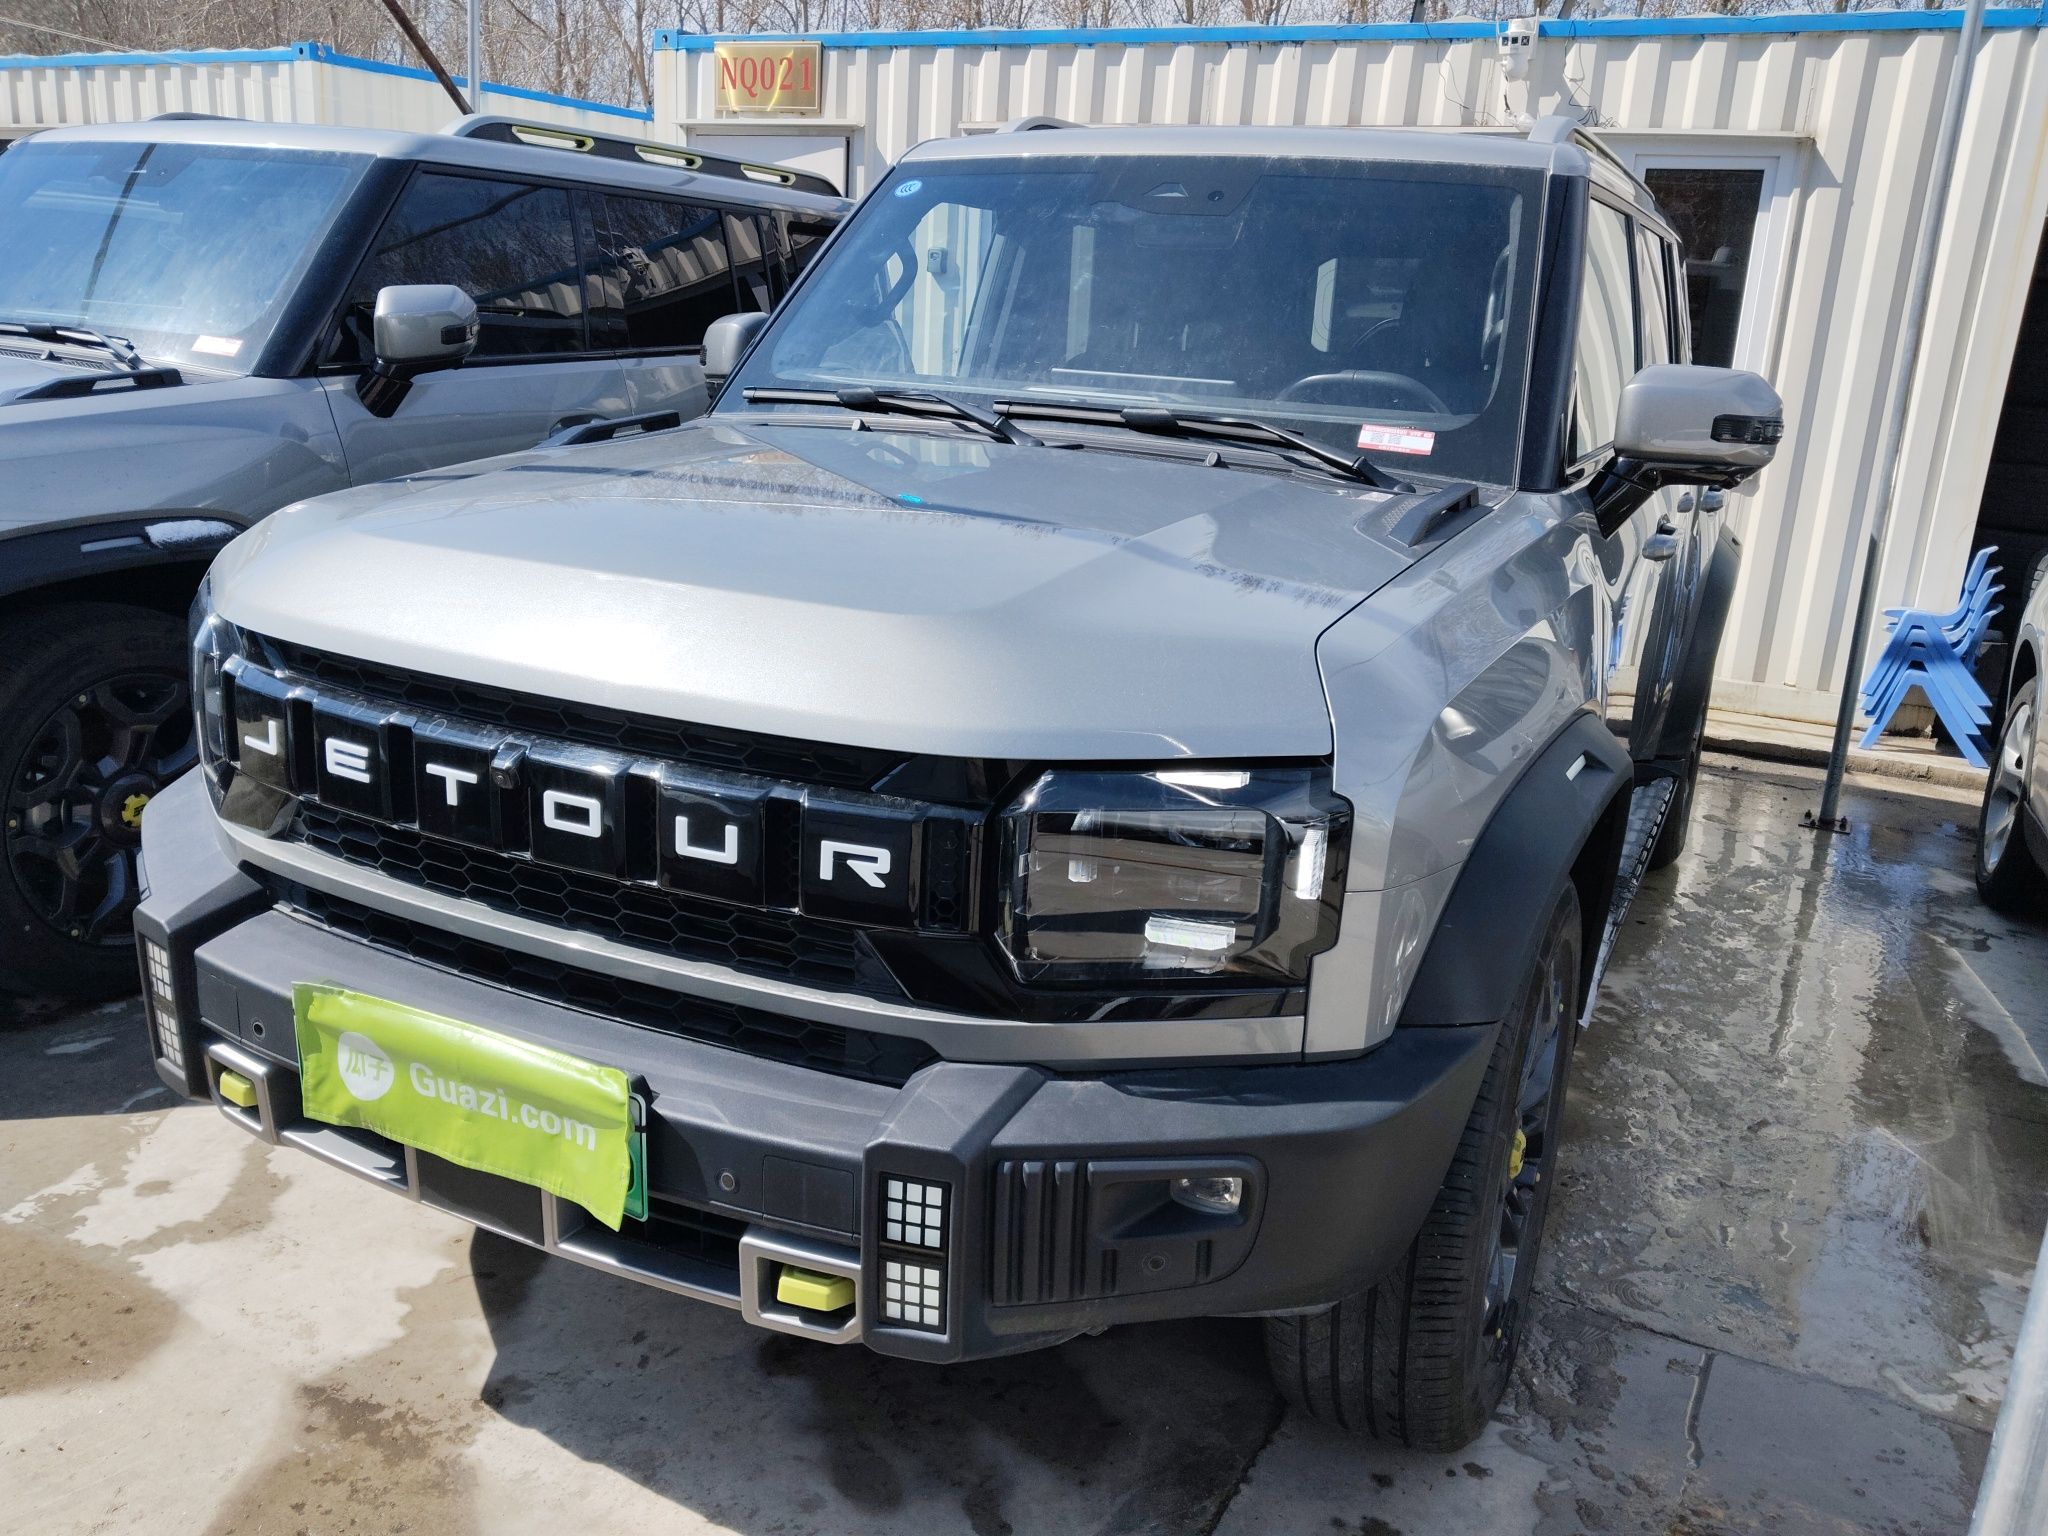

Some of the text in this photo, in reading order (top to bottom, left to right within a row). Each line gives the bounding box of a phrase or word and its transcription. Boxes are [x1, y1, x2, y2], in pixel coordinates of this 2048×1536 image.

[720, 57, 811, 98] NQ021
[243, 720, 891, 889] JETOUR
[345, 1047, 389, 1081] 瓜子
[409, 1062, 596, 1152] Guazi.com
